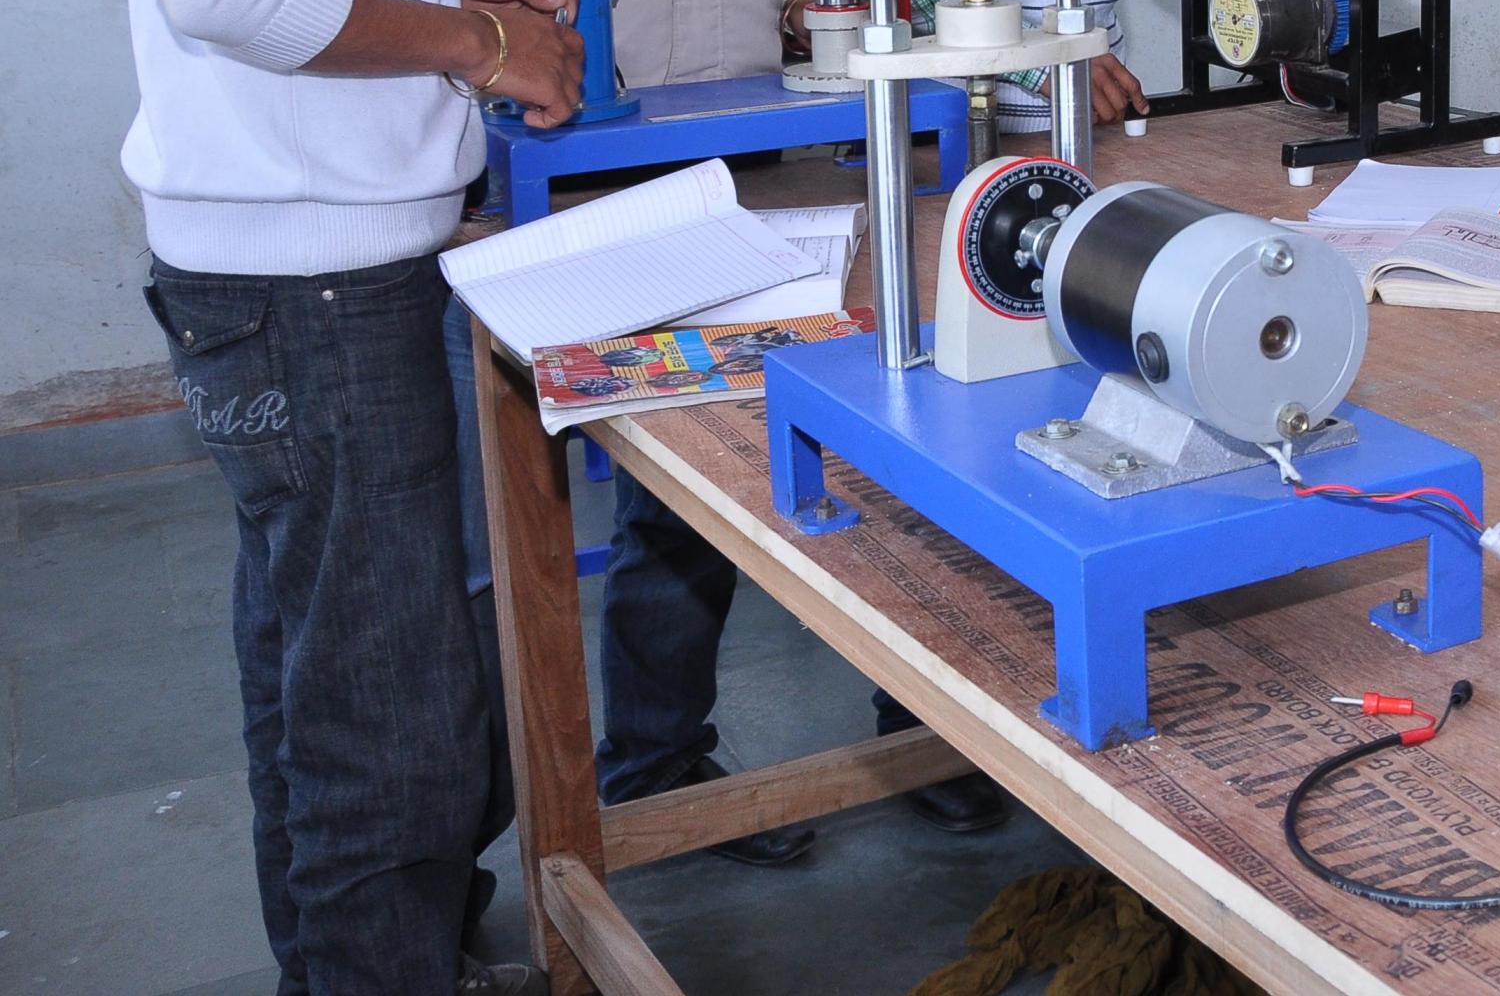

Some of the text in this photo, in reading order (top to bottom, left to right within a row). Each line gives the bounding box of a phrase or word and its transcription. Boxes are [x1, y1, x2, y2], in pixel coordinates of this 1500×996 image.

[1256, 676, 1321, 725] BOARD
[1309, 713, 1366, 758] LOCK
[1194, 817, 1270, 881] RESISTANT
